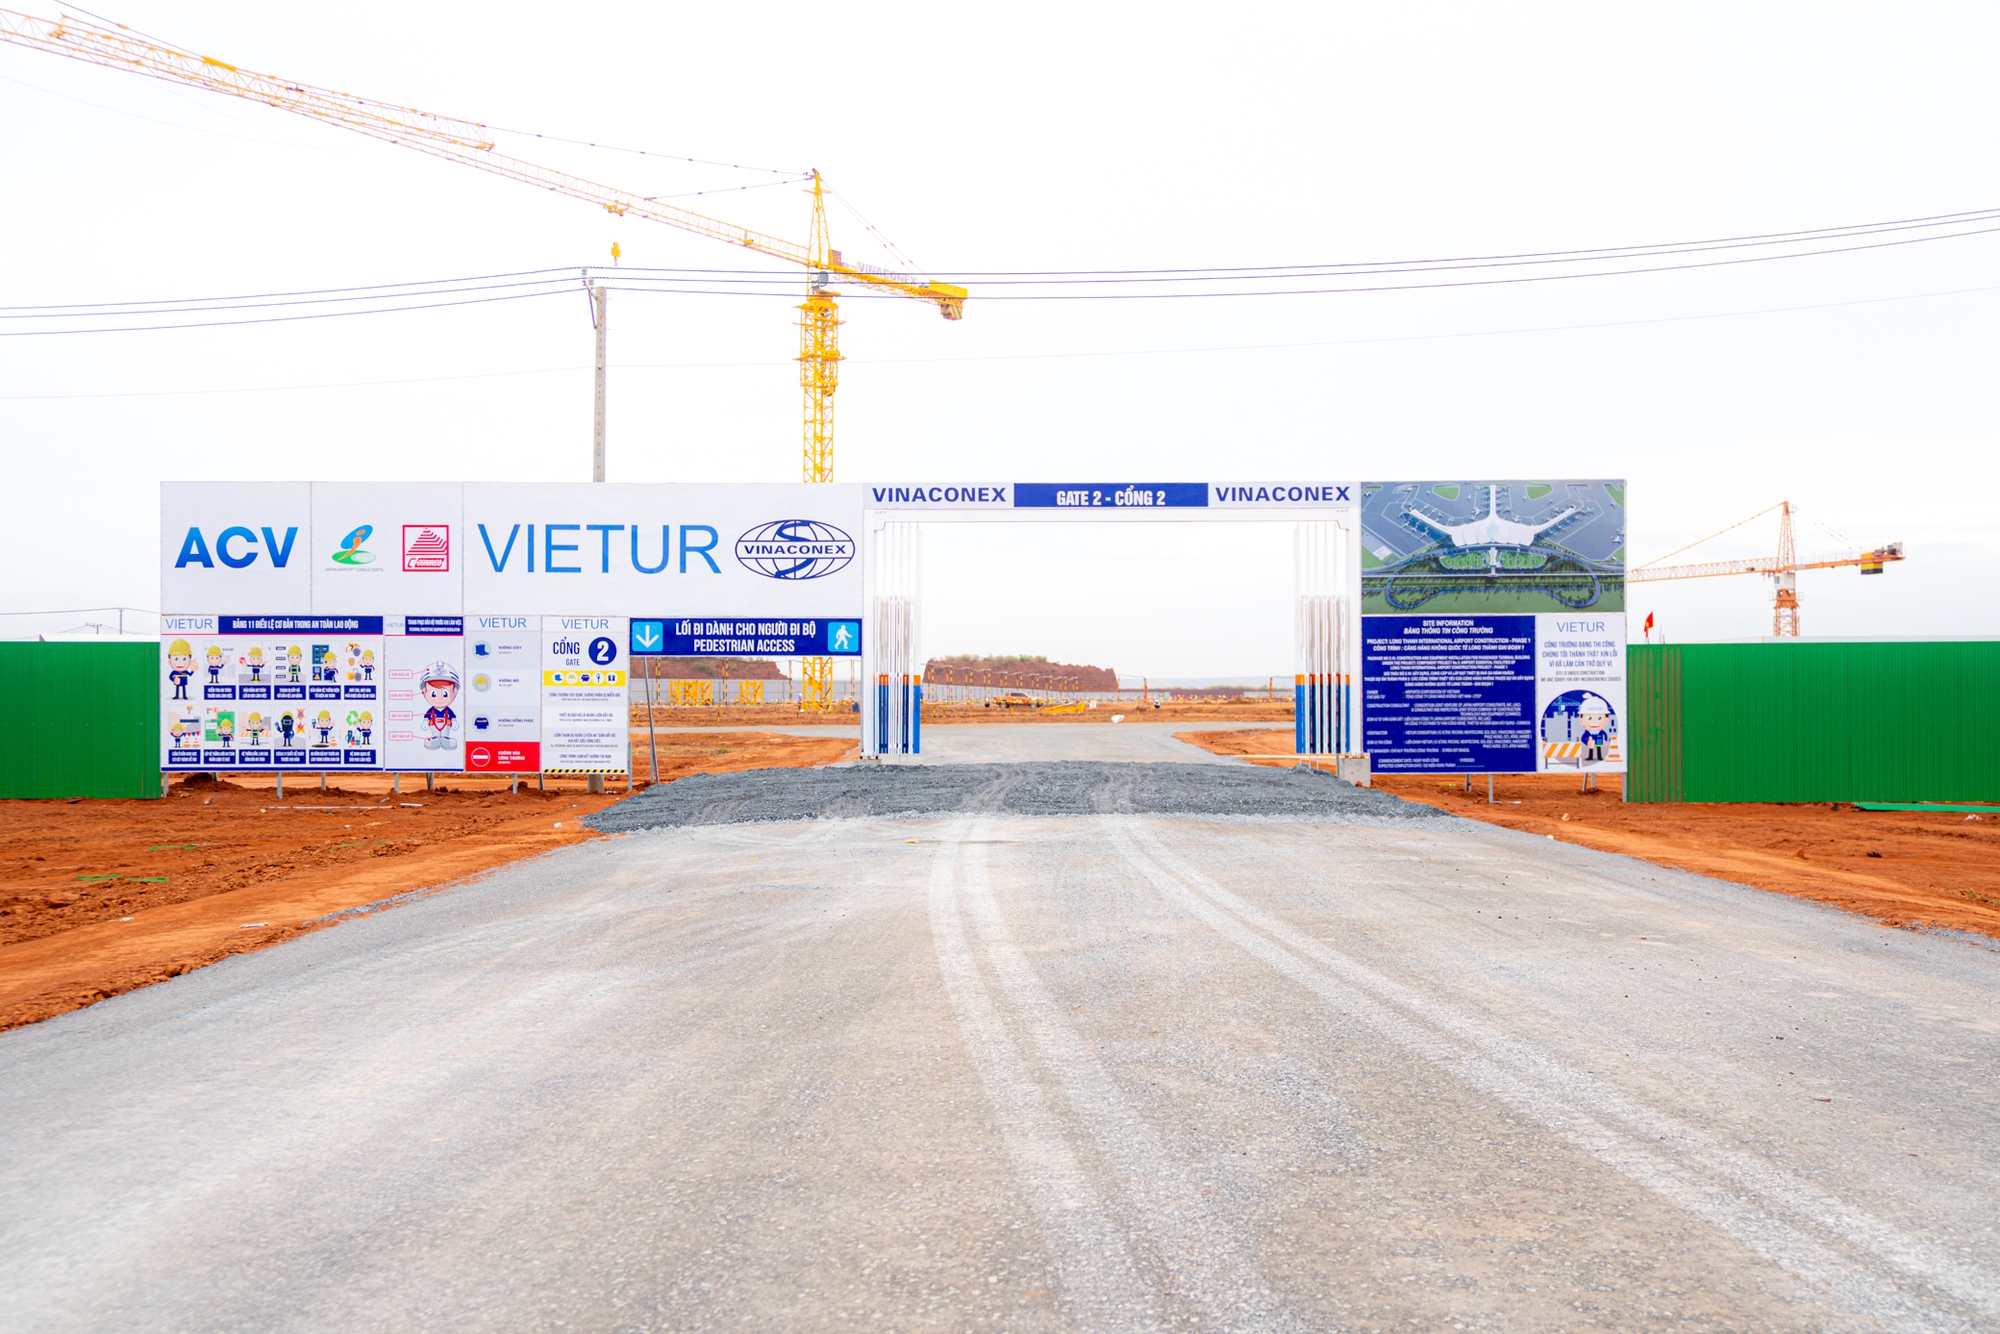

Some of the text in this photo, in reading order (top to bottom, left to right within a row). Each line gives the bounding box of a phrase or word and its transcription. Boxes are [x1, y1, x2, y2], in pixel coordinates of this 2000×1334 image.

[872, 487, 1006, 503] VINACONEX
[1056, 490, 1089, 506] GATE
[1092, 490, 1102, 506] 2
[1115, 485, 1153, 506] CỔNG
[1156, 490, 1166, 506] 2
[1215, 487, 1350, 502] VINACONEX
[174, 526, 299, 568] ACV
[477, 524, 722, 574] VIETUR
[743, 544, 847, 555] VINACONEX
[165, 618, 213, 629] VIETUR
[248, 620, 254, 629] 11
[294, 620, 311, 629] TRONG
[312, 620, 319, 629] AN
[320, 618, 333, 629] TOÀN
[334, 620, 343, 629] LAO
[479, 617, 527, 628] VIETUR
[561, 618, 609, 629] VIETUR
[676, 619, 816, 638] LỐI ĐI DÀNH CHO NGƯỜI ĐI BỘ
[1556, 622, 1605, 632] VIETUR
[553, 636, 580, 655] CỔNG
[596, 640, 609, 662] 2
[694, 640, 795, 652] PEDESTRIAN ACCESS
[566, 658, 580, 666] GATE
